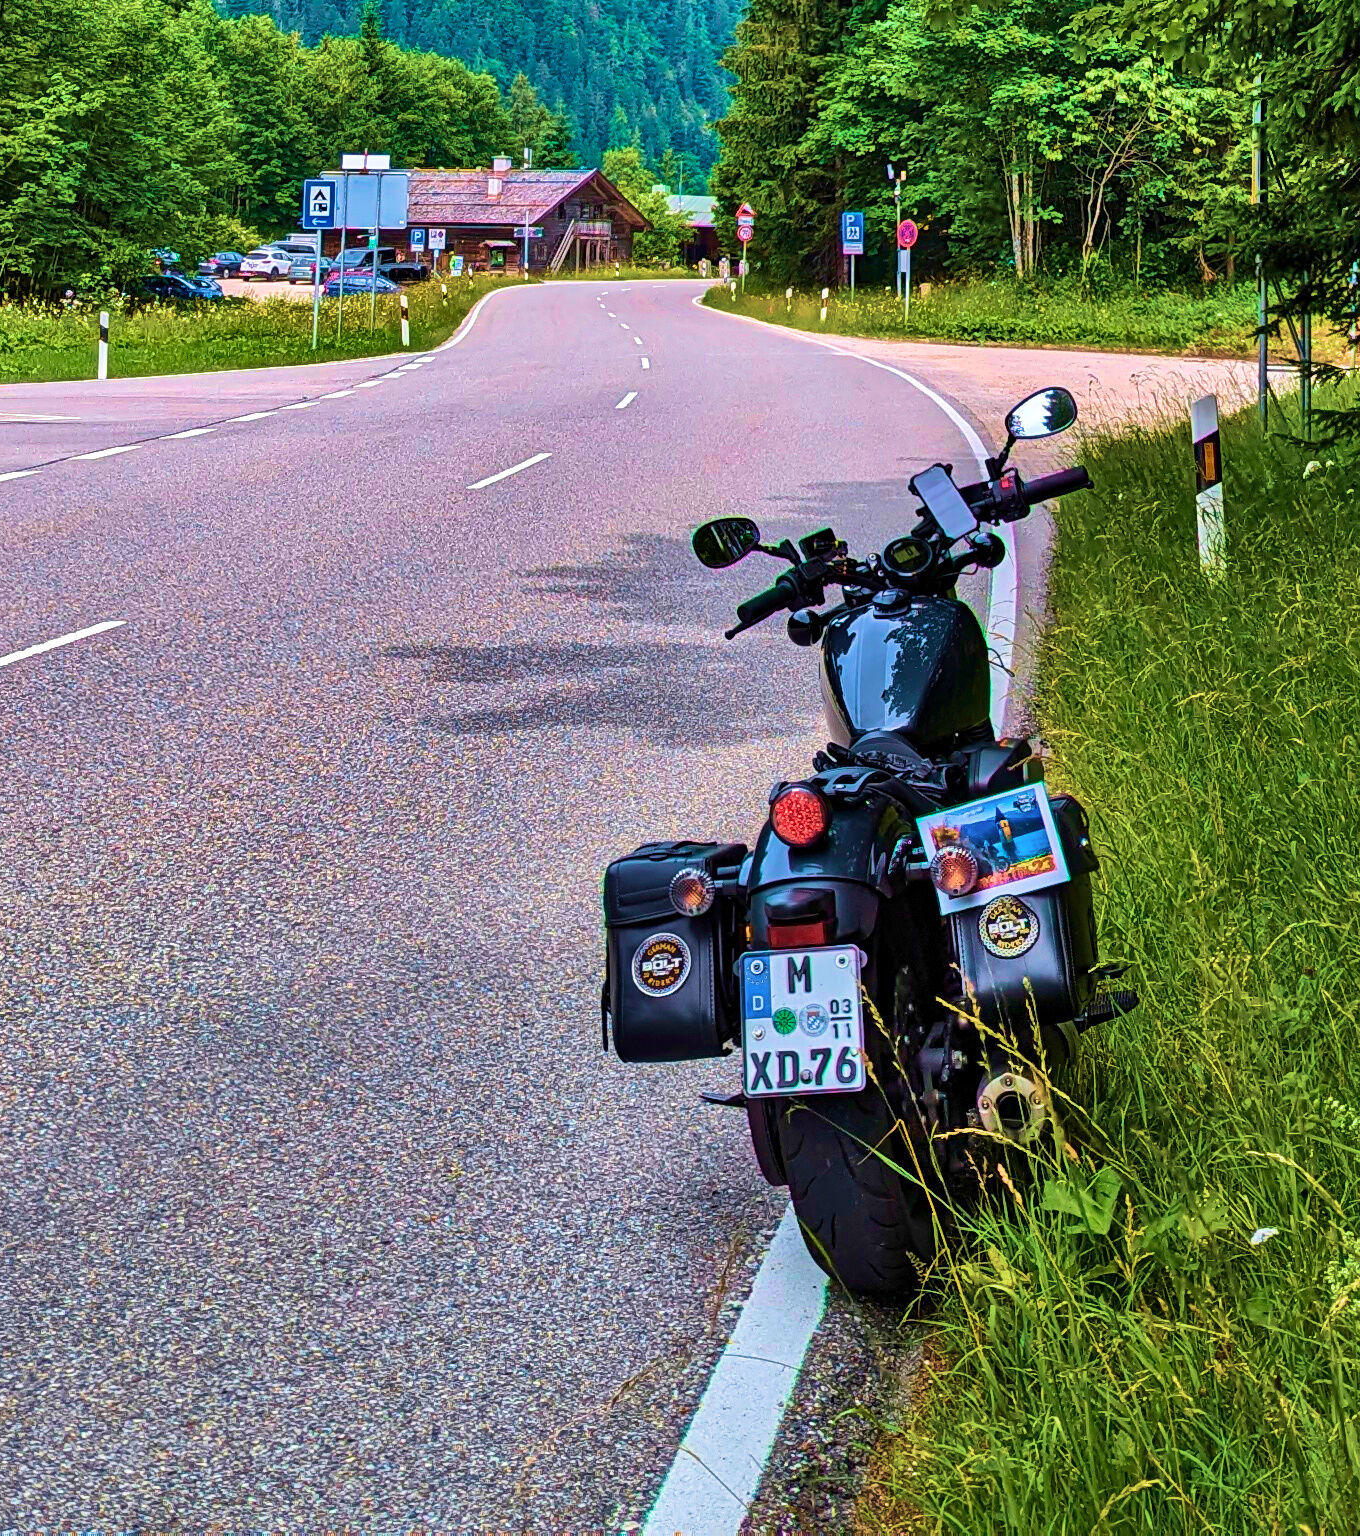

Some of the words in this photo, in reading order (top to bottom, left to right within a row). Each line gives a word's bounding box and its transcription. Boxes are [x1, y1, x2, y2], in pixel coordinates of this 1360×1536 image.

[646, 942, 677, 956] GERMAN
[641, 957, 683, 972] BOLT
[787, 955, 812, 994] M
[752, 995, 764, 1011] D
[830, 998, 852, 1015] 03
[832, 1023, 852, 1039] 11
